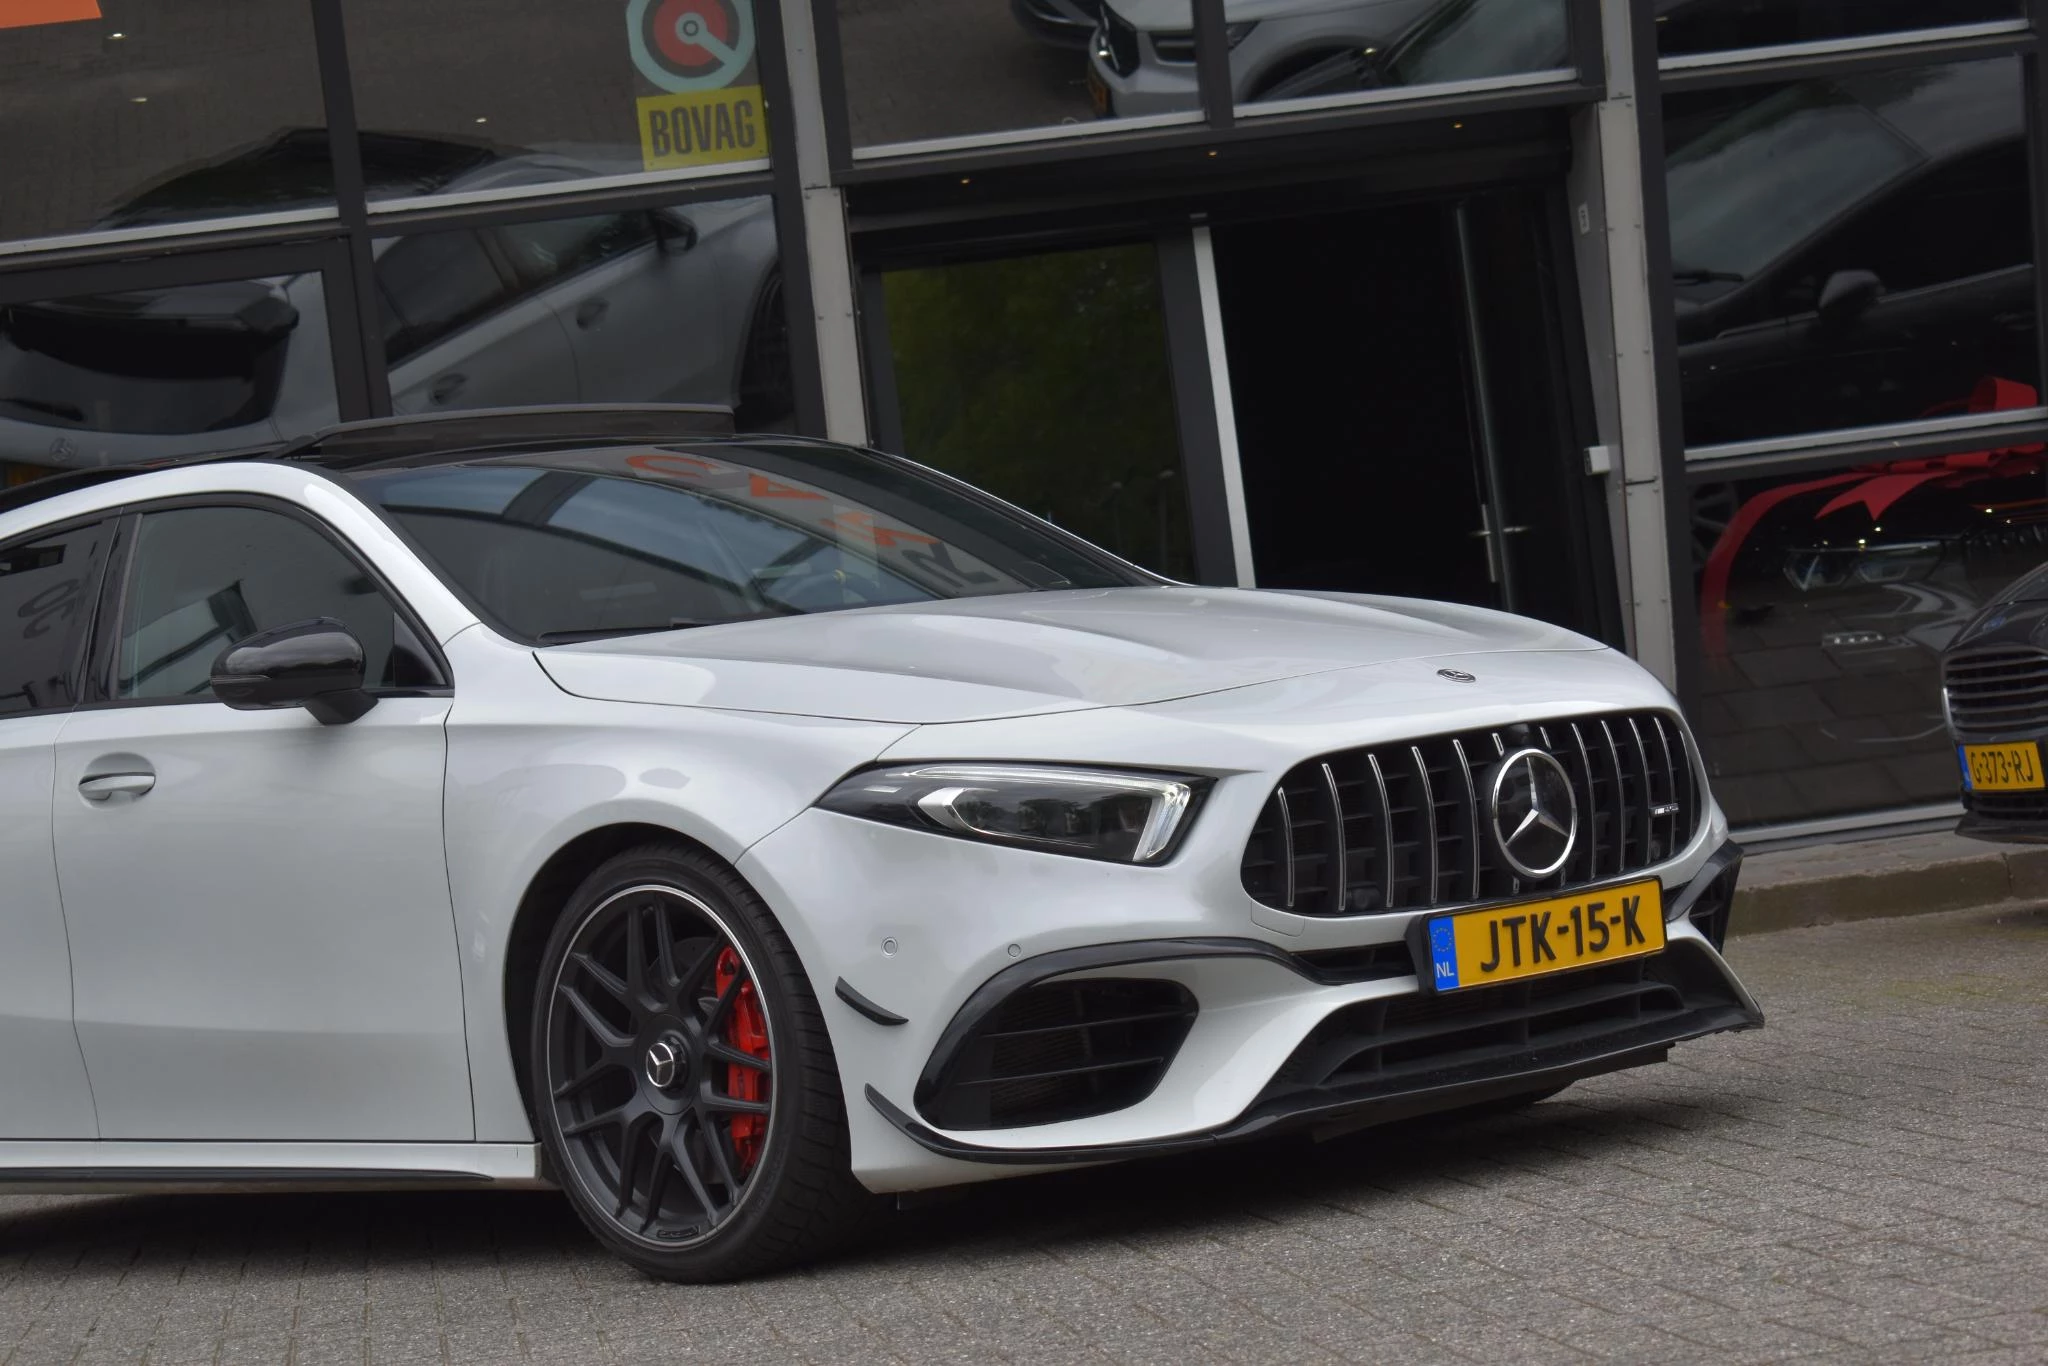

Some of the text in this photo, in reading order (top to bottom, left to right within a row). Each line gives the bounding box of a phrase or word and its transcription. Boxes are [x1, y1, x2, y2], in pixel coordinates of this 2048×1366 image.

[649, 100, 755, 157] BOVAG
[1970, 749, 2033, 784] G-373-RJ
[1480, 896, 1645, 973] JTK-15-K
[1436, 962, 1455, 979] NL
